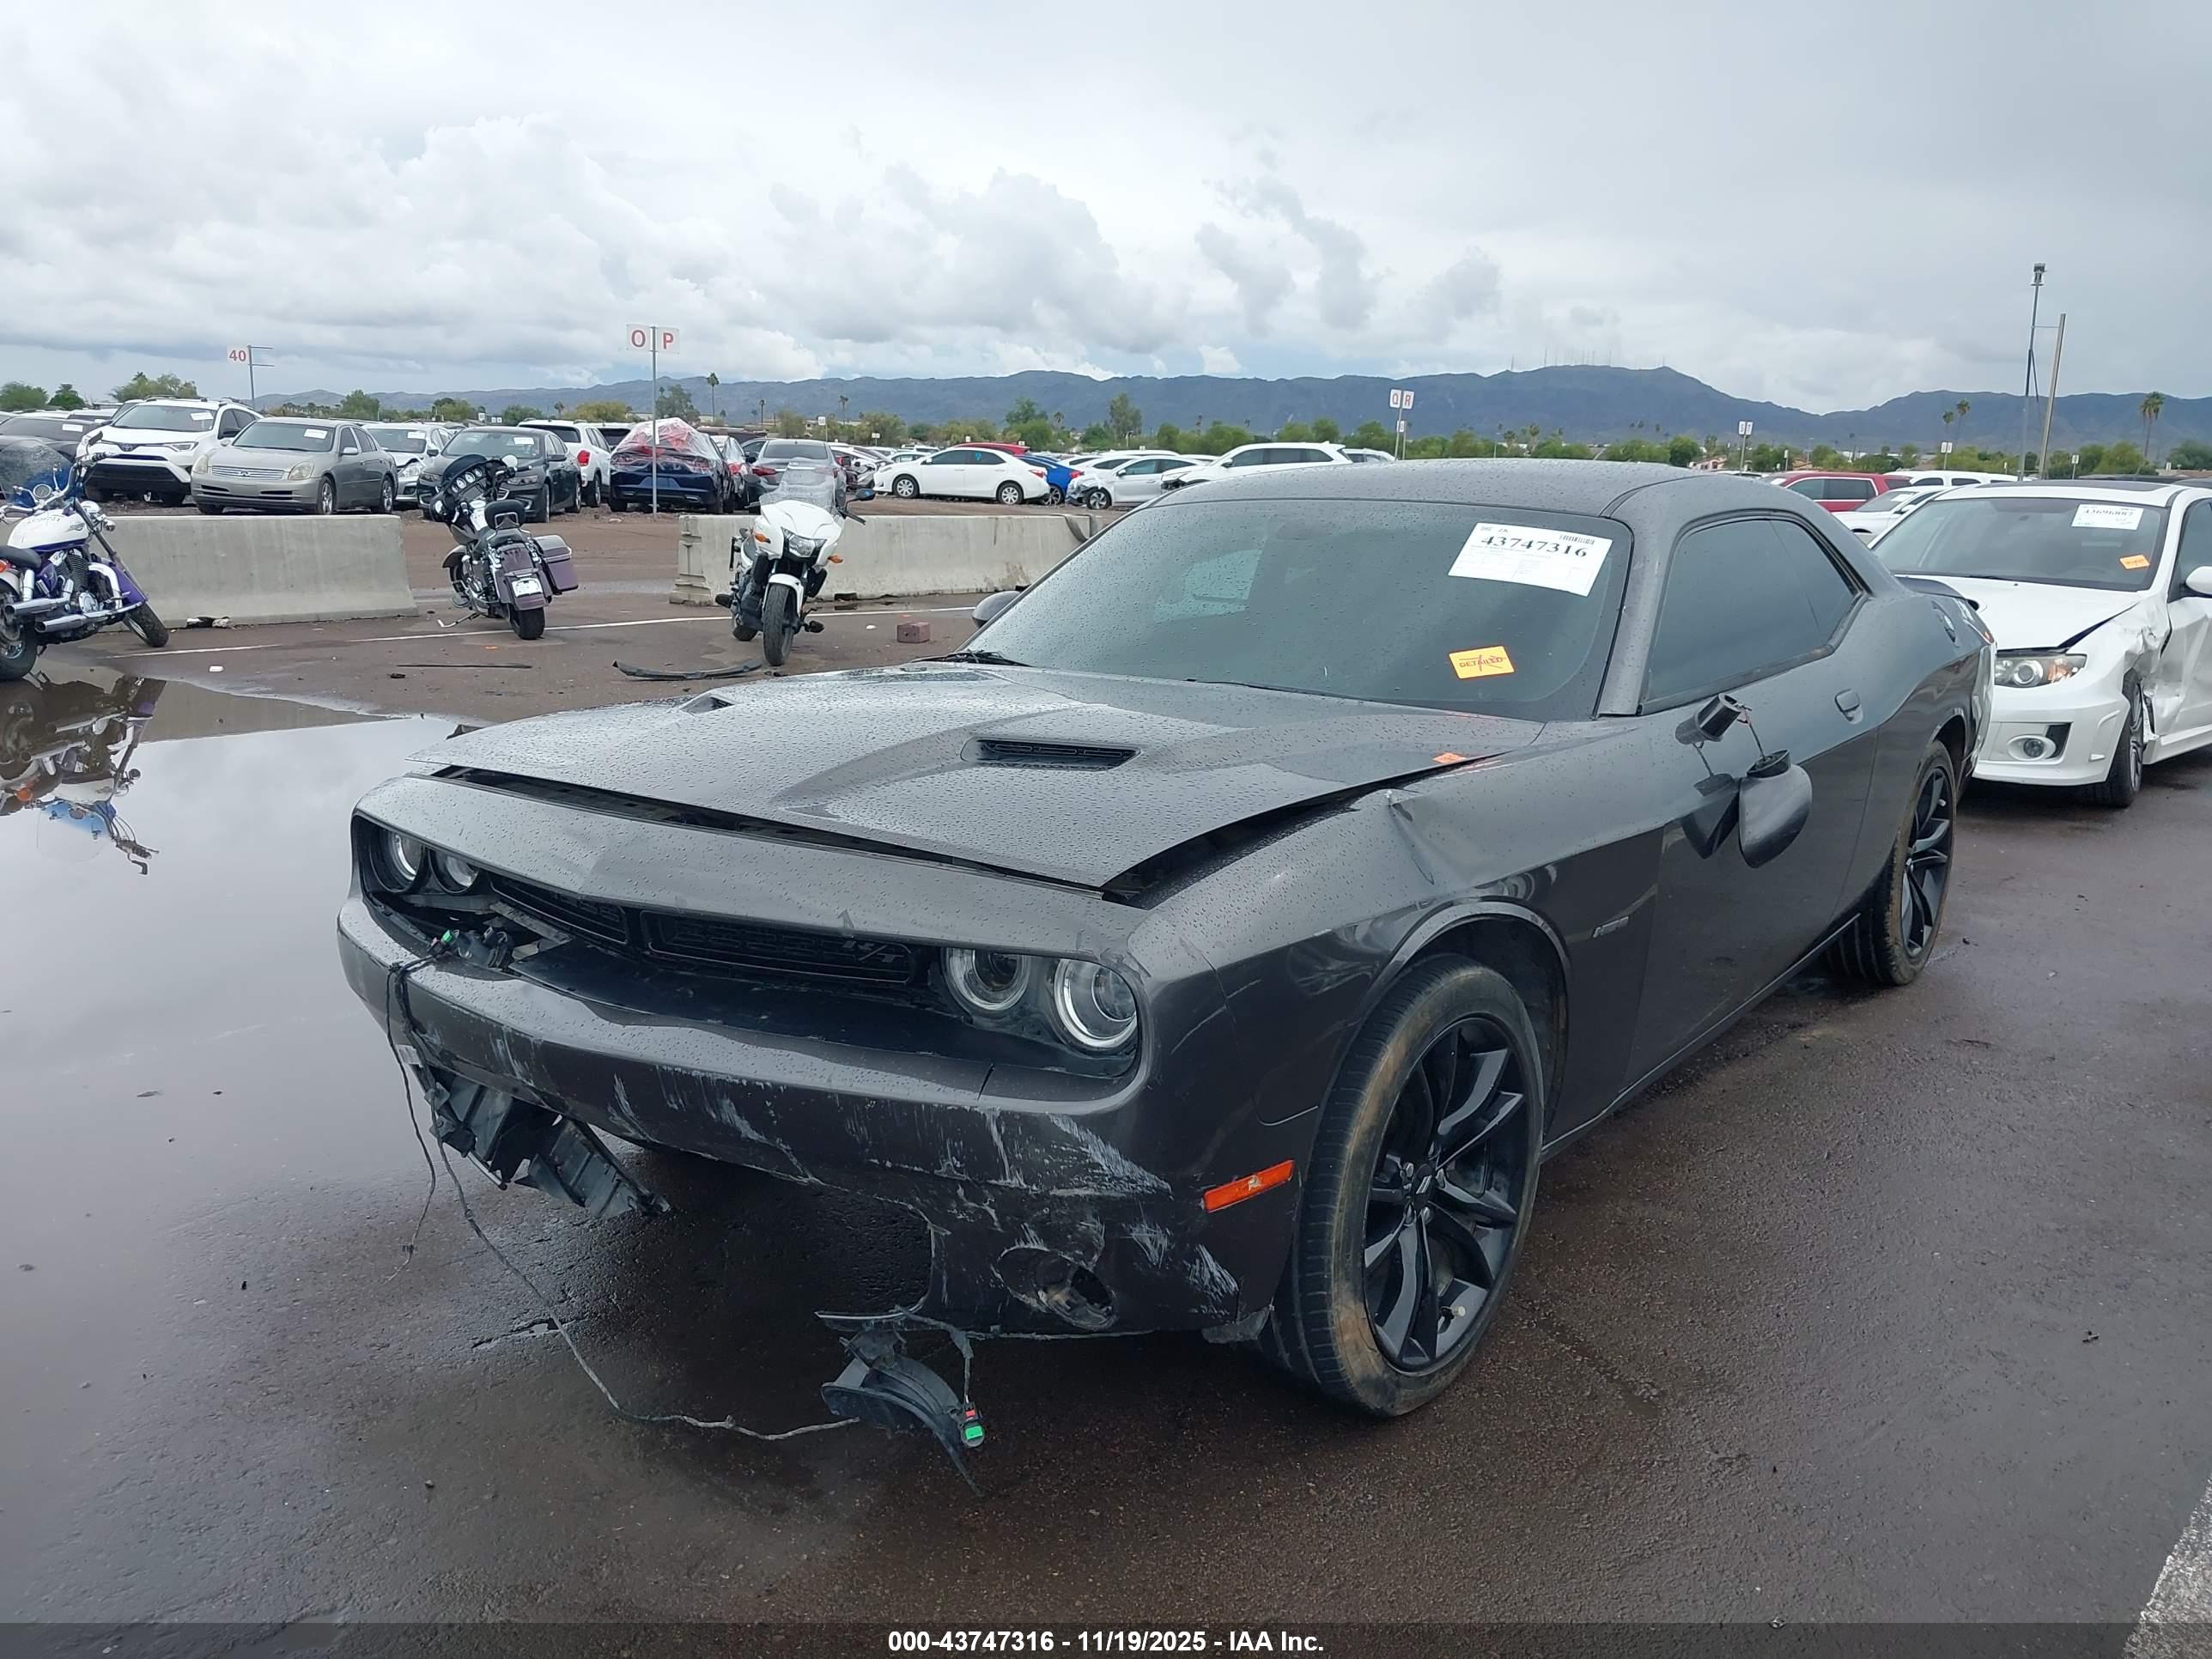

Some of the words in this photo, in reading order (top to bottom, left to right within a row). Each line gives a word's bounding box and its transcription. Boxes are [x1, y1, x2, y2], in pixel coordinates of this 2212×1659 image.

[631, 329, 647, 348] O
[663, 331, 674, 350] P
[229, 349, 247, 362] 40
[1405, 394, 1411, 406] R
[1480, 535, 1588, 558] 43747316
[1459, 656, 1504, 668] DETAILED
